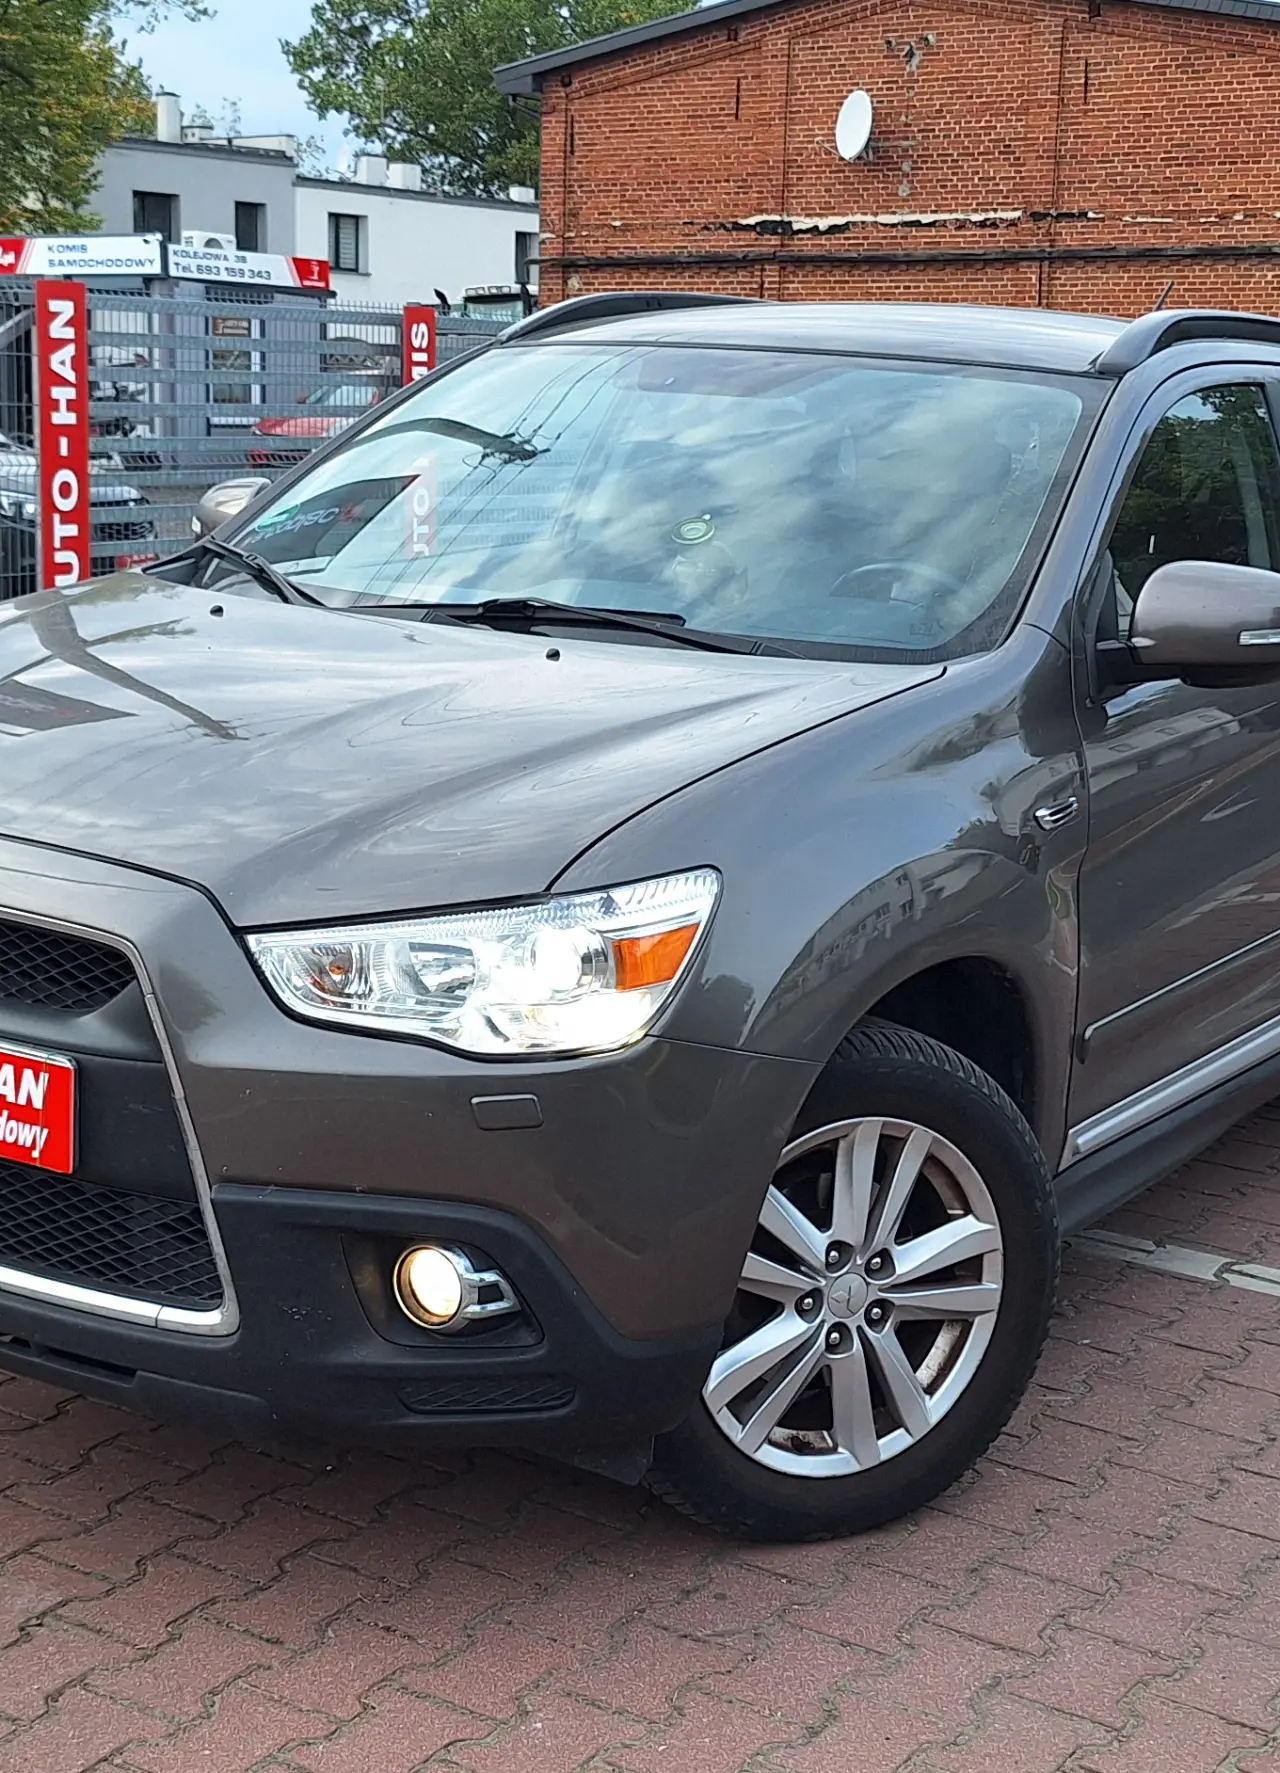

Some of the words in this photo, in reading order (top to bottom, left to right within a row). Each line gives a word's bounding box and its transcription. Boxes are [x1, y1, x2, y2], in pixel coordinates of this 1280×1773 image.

[47, 243, 88, 254] KOMIS
[172, 249, 230, 262] KOLEJOWA
[47, 258, 156, 268] SAMOCHODOWY
[196, 264, 221, 276] 693
[224, 266, 246, 278] 159
[247, 268, 272, 280] 343
[48, 298, 78, 426] HAN
[52, 468, 80, 588] UTO
